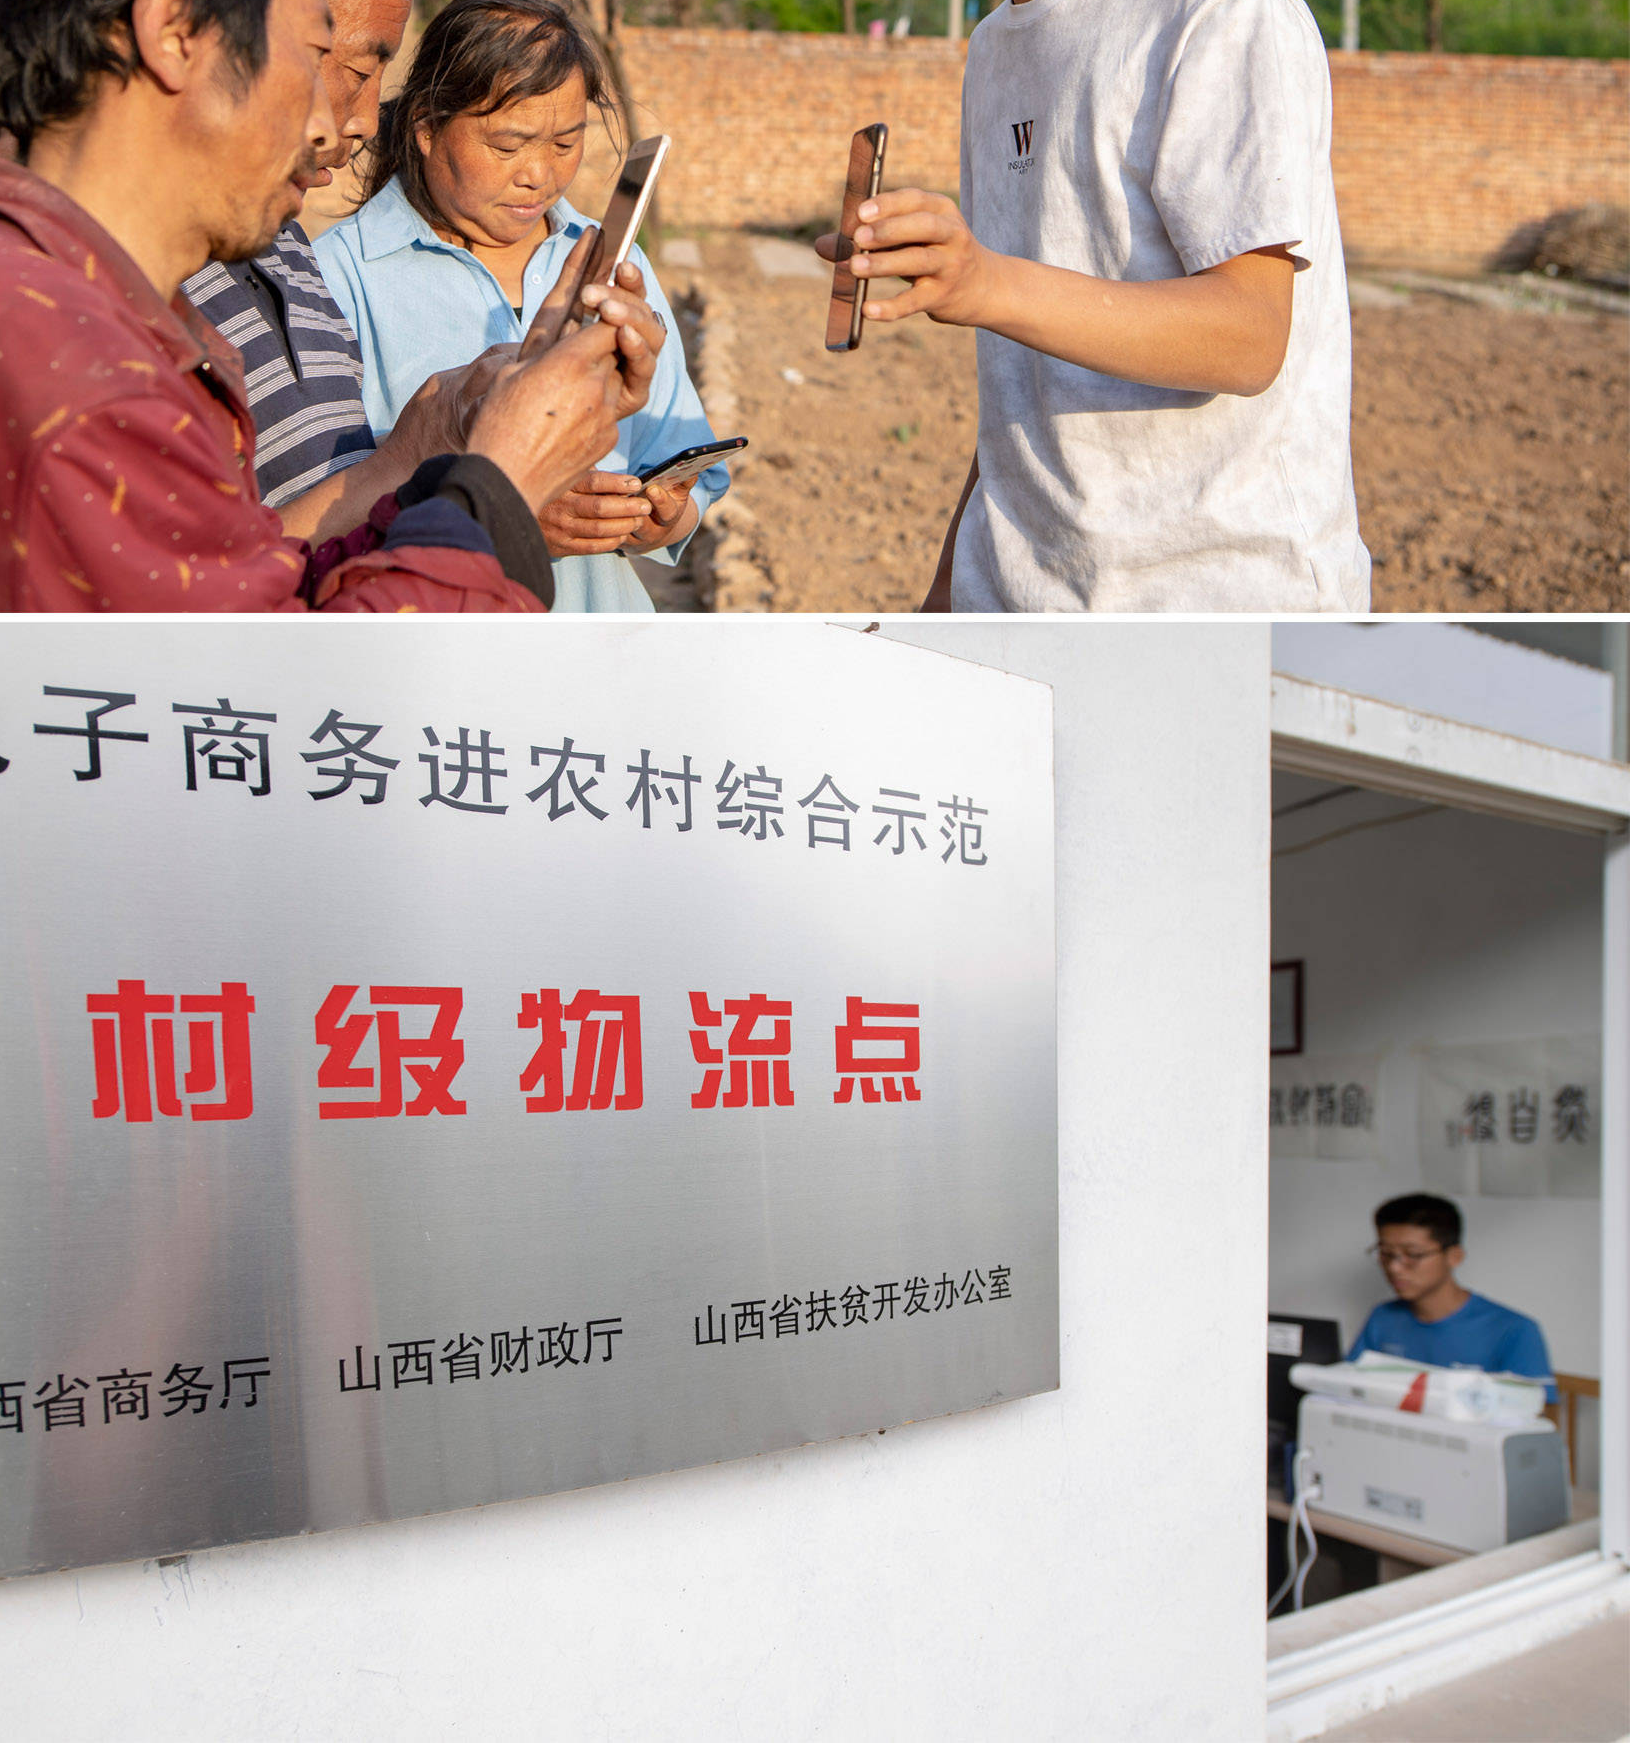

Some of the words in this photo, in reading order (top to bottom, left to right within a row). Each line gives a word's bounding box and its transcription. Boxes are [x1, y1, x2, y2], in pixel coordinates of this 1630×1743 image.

[1011, 120, 1034, 157] W
[87, 979, 922, 1123] 村级物流点
[338, 1316, 623, 1394] 山西省财政厅
[694, 1264, 1013, 1347] 山西省扶贫开发办公室
